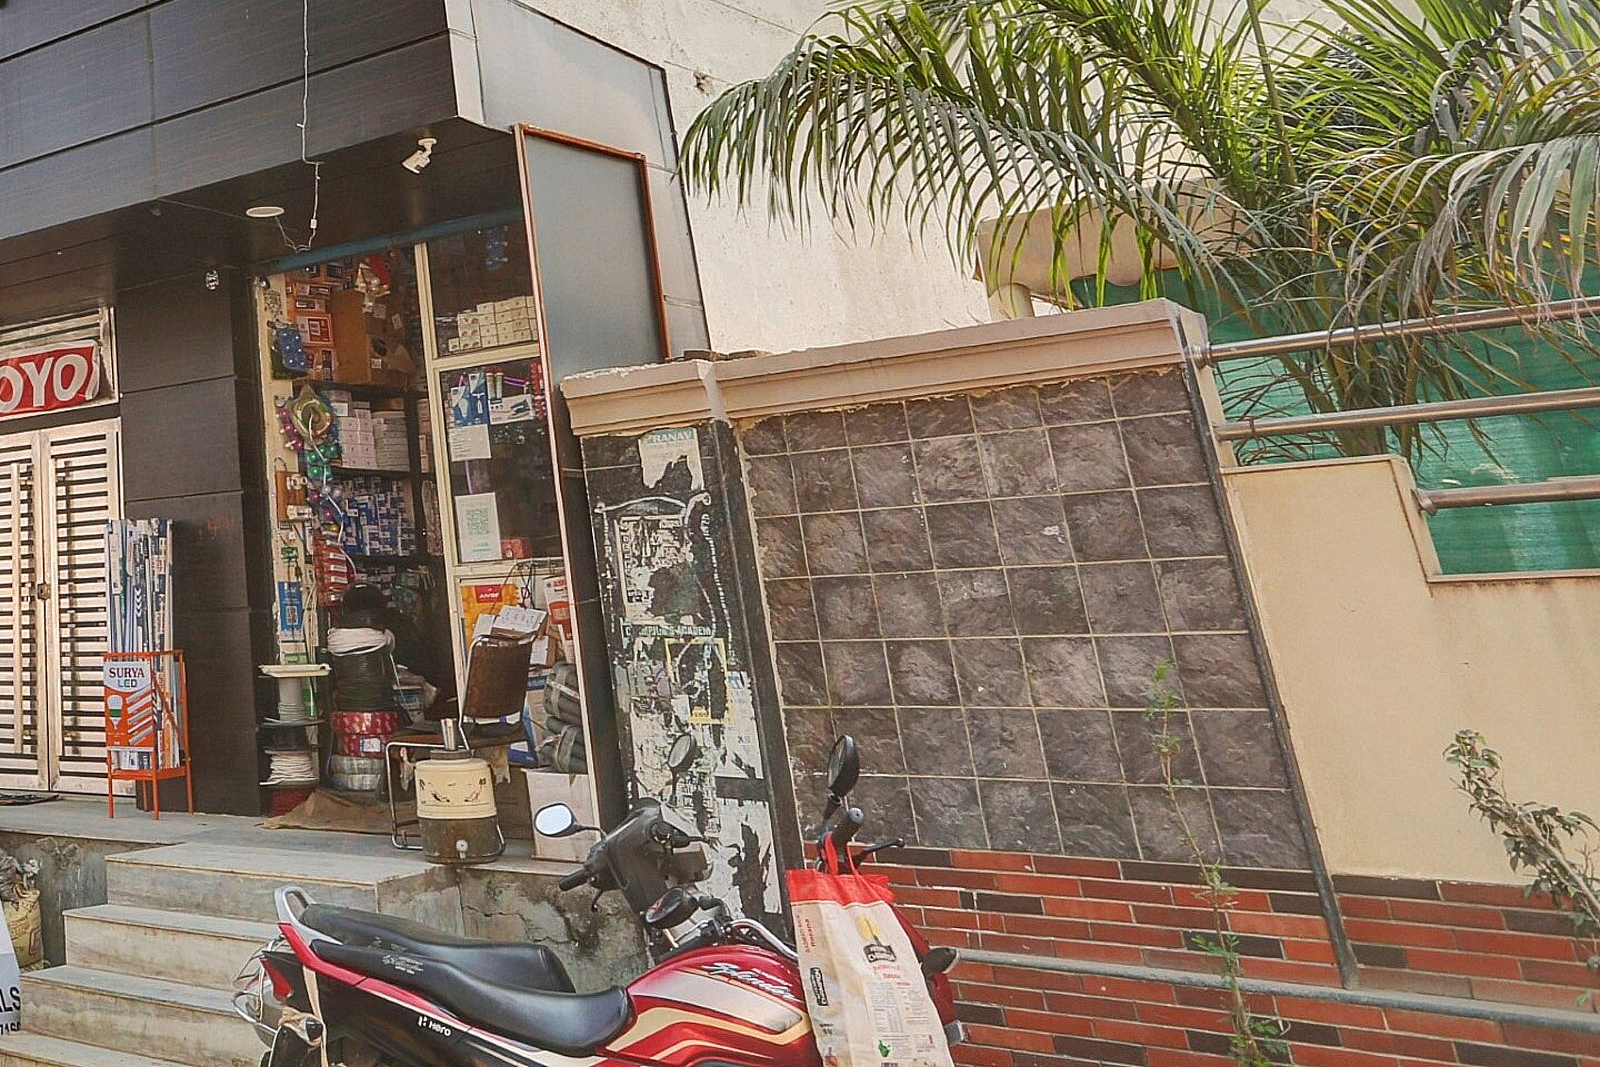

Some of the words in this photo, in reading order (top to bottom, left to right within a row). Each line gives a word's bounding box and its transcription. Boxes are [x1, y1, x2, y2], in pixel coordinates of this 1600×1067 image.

[109, 667, 145, 678] SURYA
[118, 679, 137, 687] LED
[429, 1020, 451, 1037] Hero
